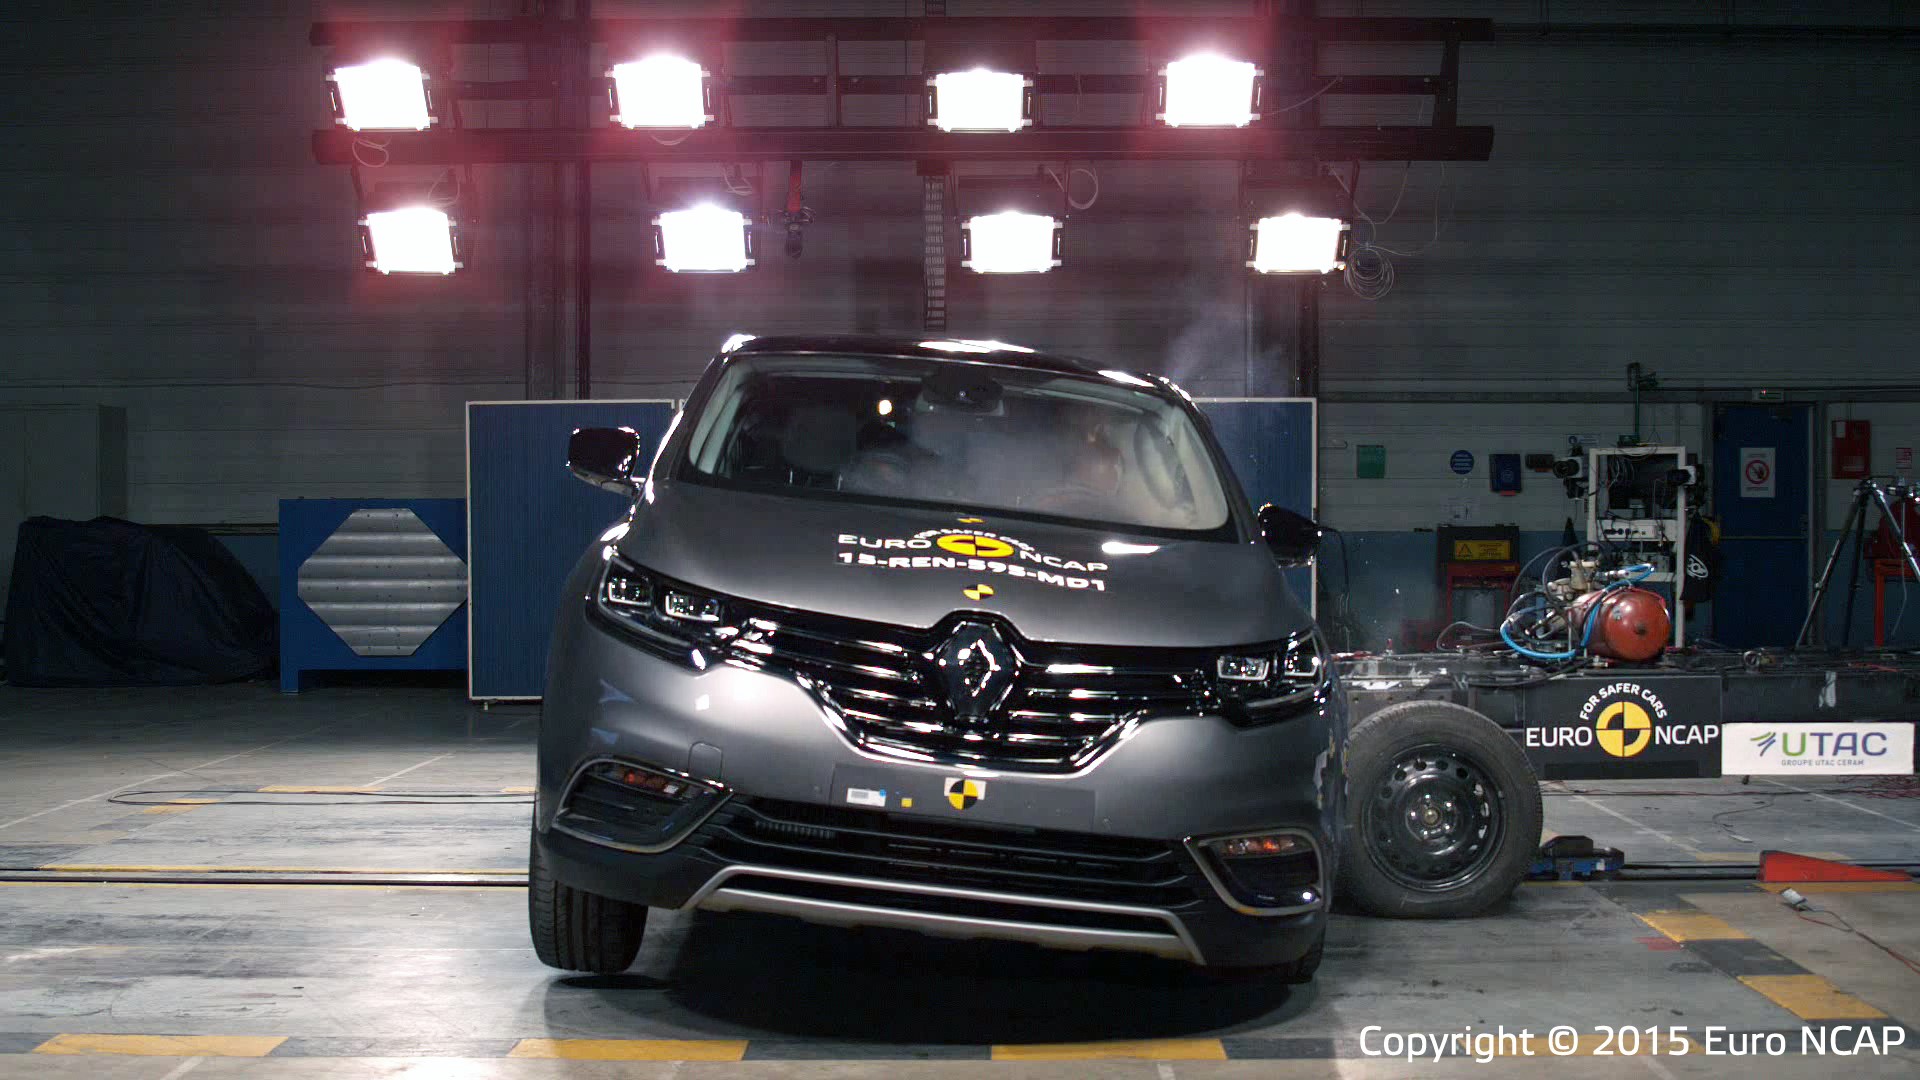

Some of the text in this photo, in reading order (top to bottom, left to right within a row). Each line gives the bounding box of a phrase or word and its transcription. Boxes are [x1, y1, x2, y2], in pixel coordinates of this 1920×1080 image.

[838, 534, 932, 549] EURO
[1019, 550, 1109, 571] NCAP
[1579, 682, 1668, 720] FOR SAFER CARS
[1526, 724, 1719, 747] EURO NCAP
[1782, 731, 1888, 757] UTAC
[1781, 759, 1864, 767] GROUPE UTAC CERAM
